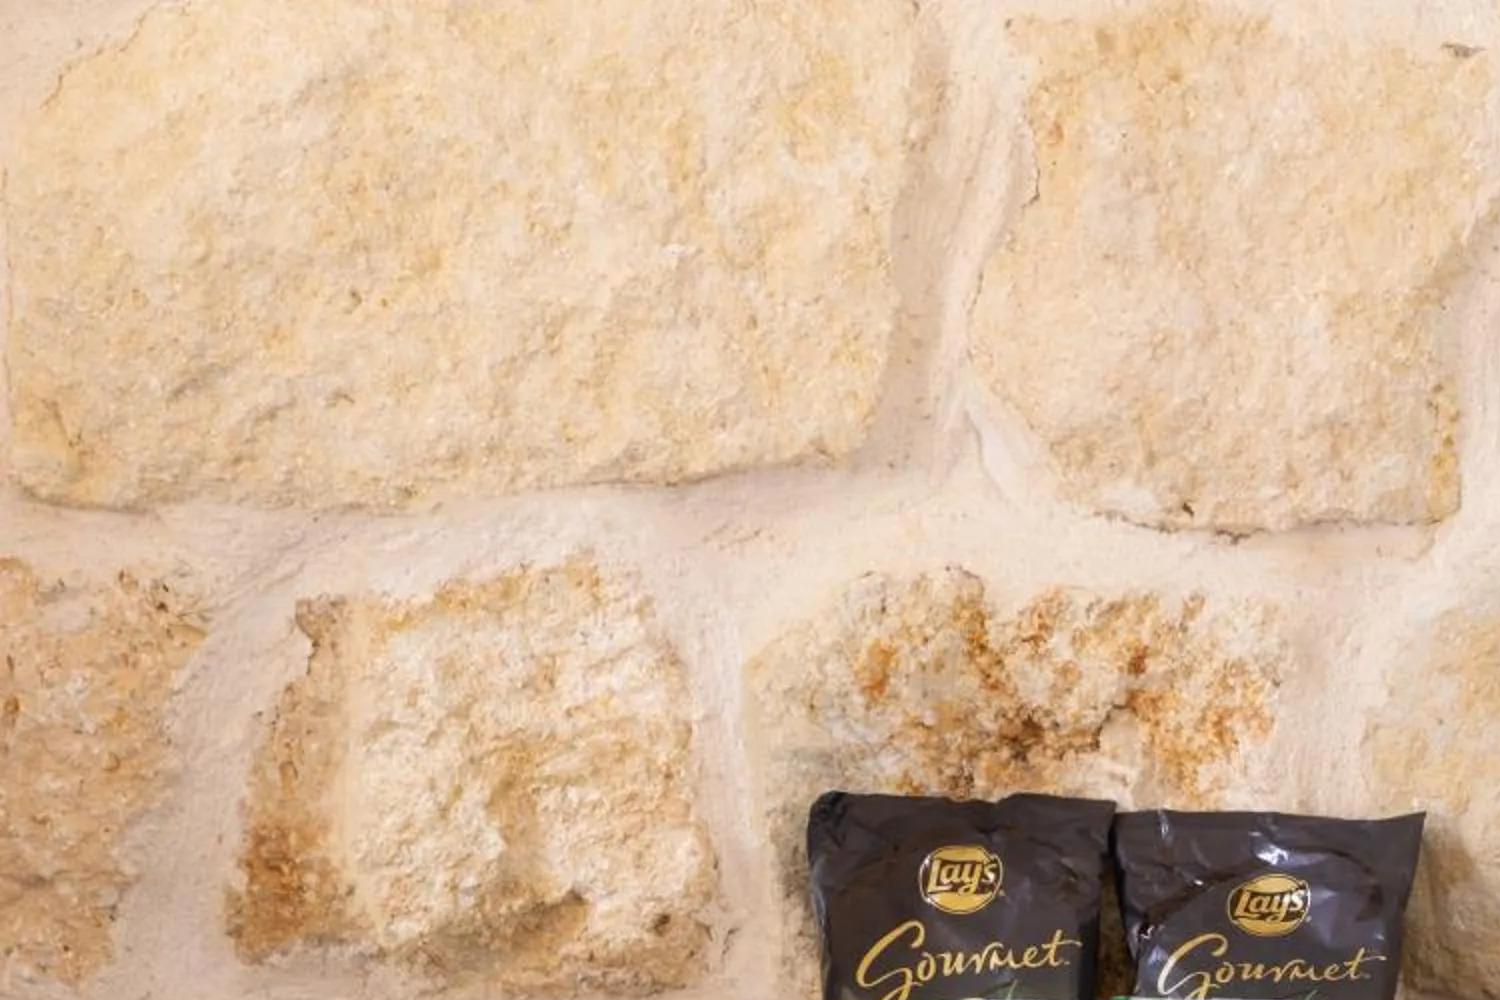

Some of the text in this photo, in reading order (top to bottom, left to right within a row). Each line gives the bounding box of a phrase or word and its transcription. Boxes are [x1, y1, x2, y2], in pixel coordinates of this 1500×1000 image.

[927, 859, 997, 895] Lay's
[1234, 887, 1305, 923] Lay's
[1156, 932, 1388, 1000] Gourmet
